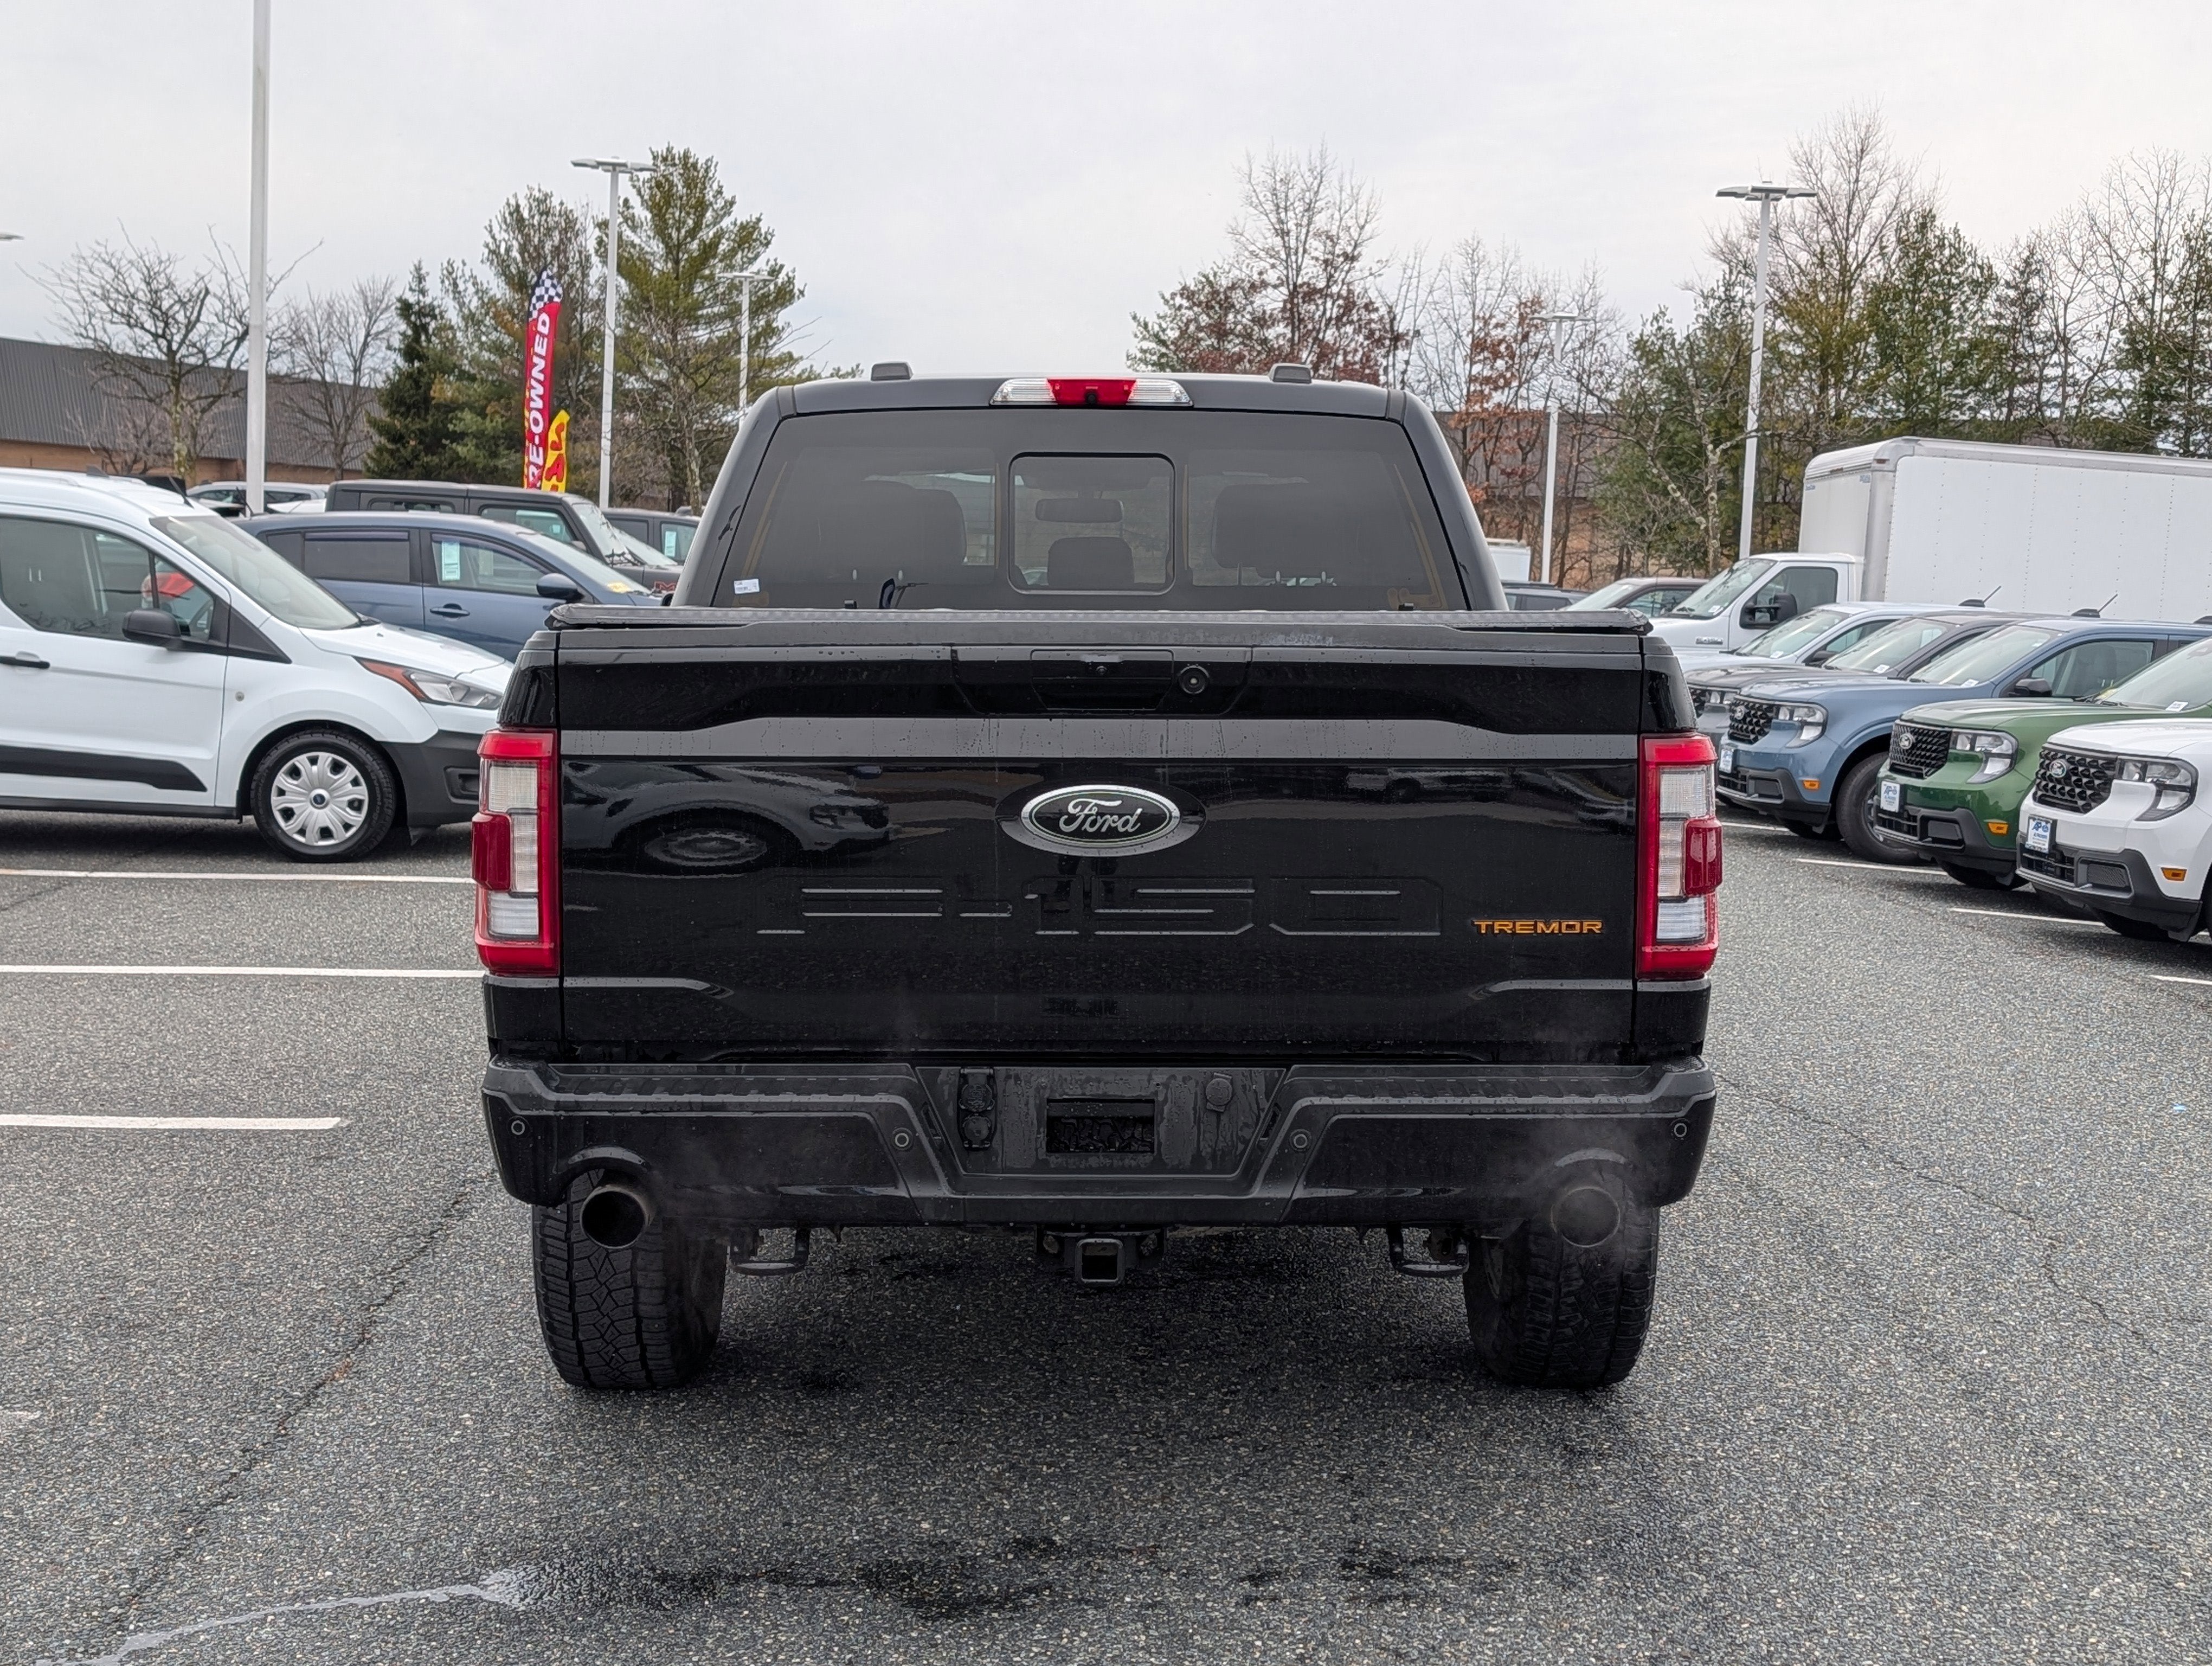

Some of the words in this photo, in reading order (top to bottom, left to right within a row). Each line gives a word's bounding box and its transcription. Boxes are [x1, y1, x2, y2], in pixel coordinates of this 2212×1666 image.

[544, 422, 565, 492] SA
[1059, 798, 1142, 832] Ford
[1473, 919, 1602, 933] TREMOR
